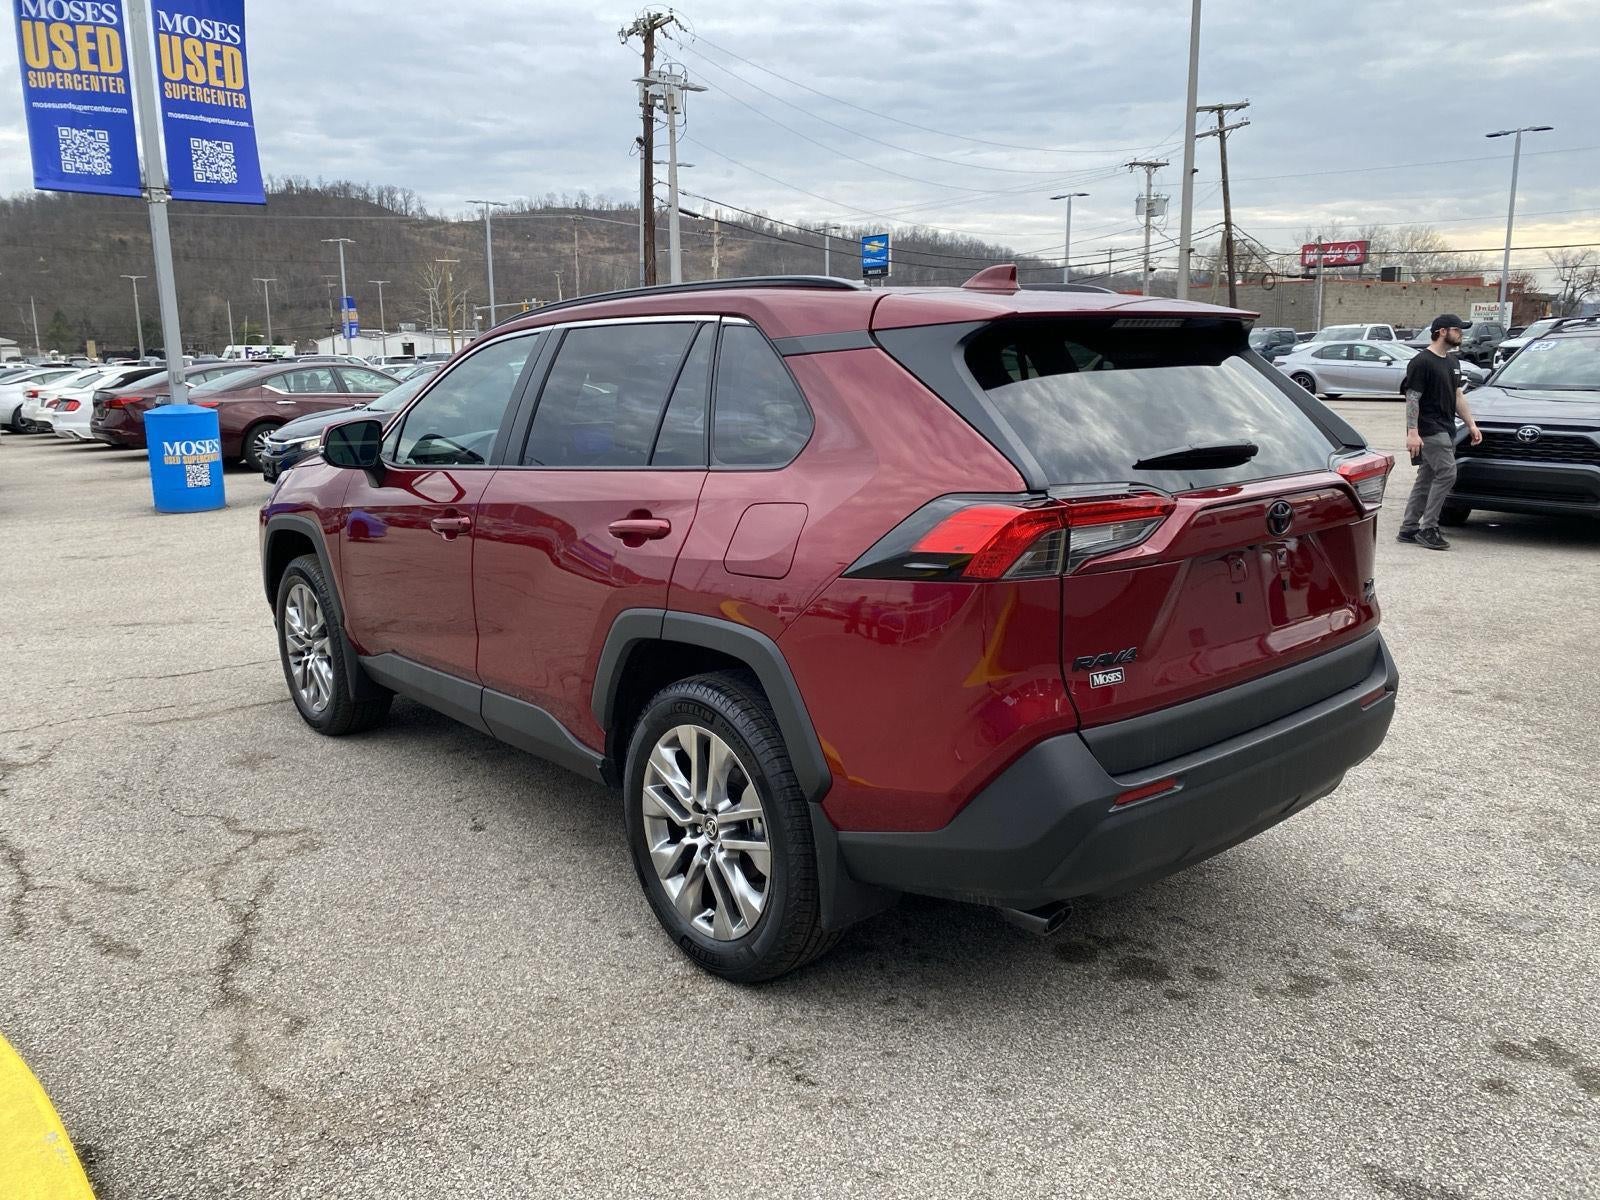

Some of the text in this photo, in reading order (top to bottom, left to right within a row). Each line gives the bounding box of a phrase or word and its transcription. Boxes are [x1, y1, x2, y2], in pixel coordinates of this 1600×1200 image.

[20, 0, 118, 25] MOSES
[157, 10, 241, 45] MOSES
[21, 20, 123, 73] USED
[158, 33, 244, 90] USED
[28, 70, 126, 94] SUPERCENTER
[164, 81, 247, 109] SUPERCENTER
[32, 101, 128, 114] mosesusedsupercenter.com
[167, 111, 250, 127] mosesusedsupercenter.com
[163, 439, 219, 456] MOSES
[1072, 647, 1136, 671] RAV4
[1093, 672, 1121, 685] MOSES
